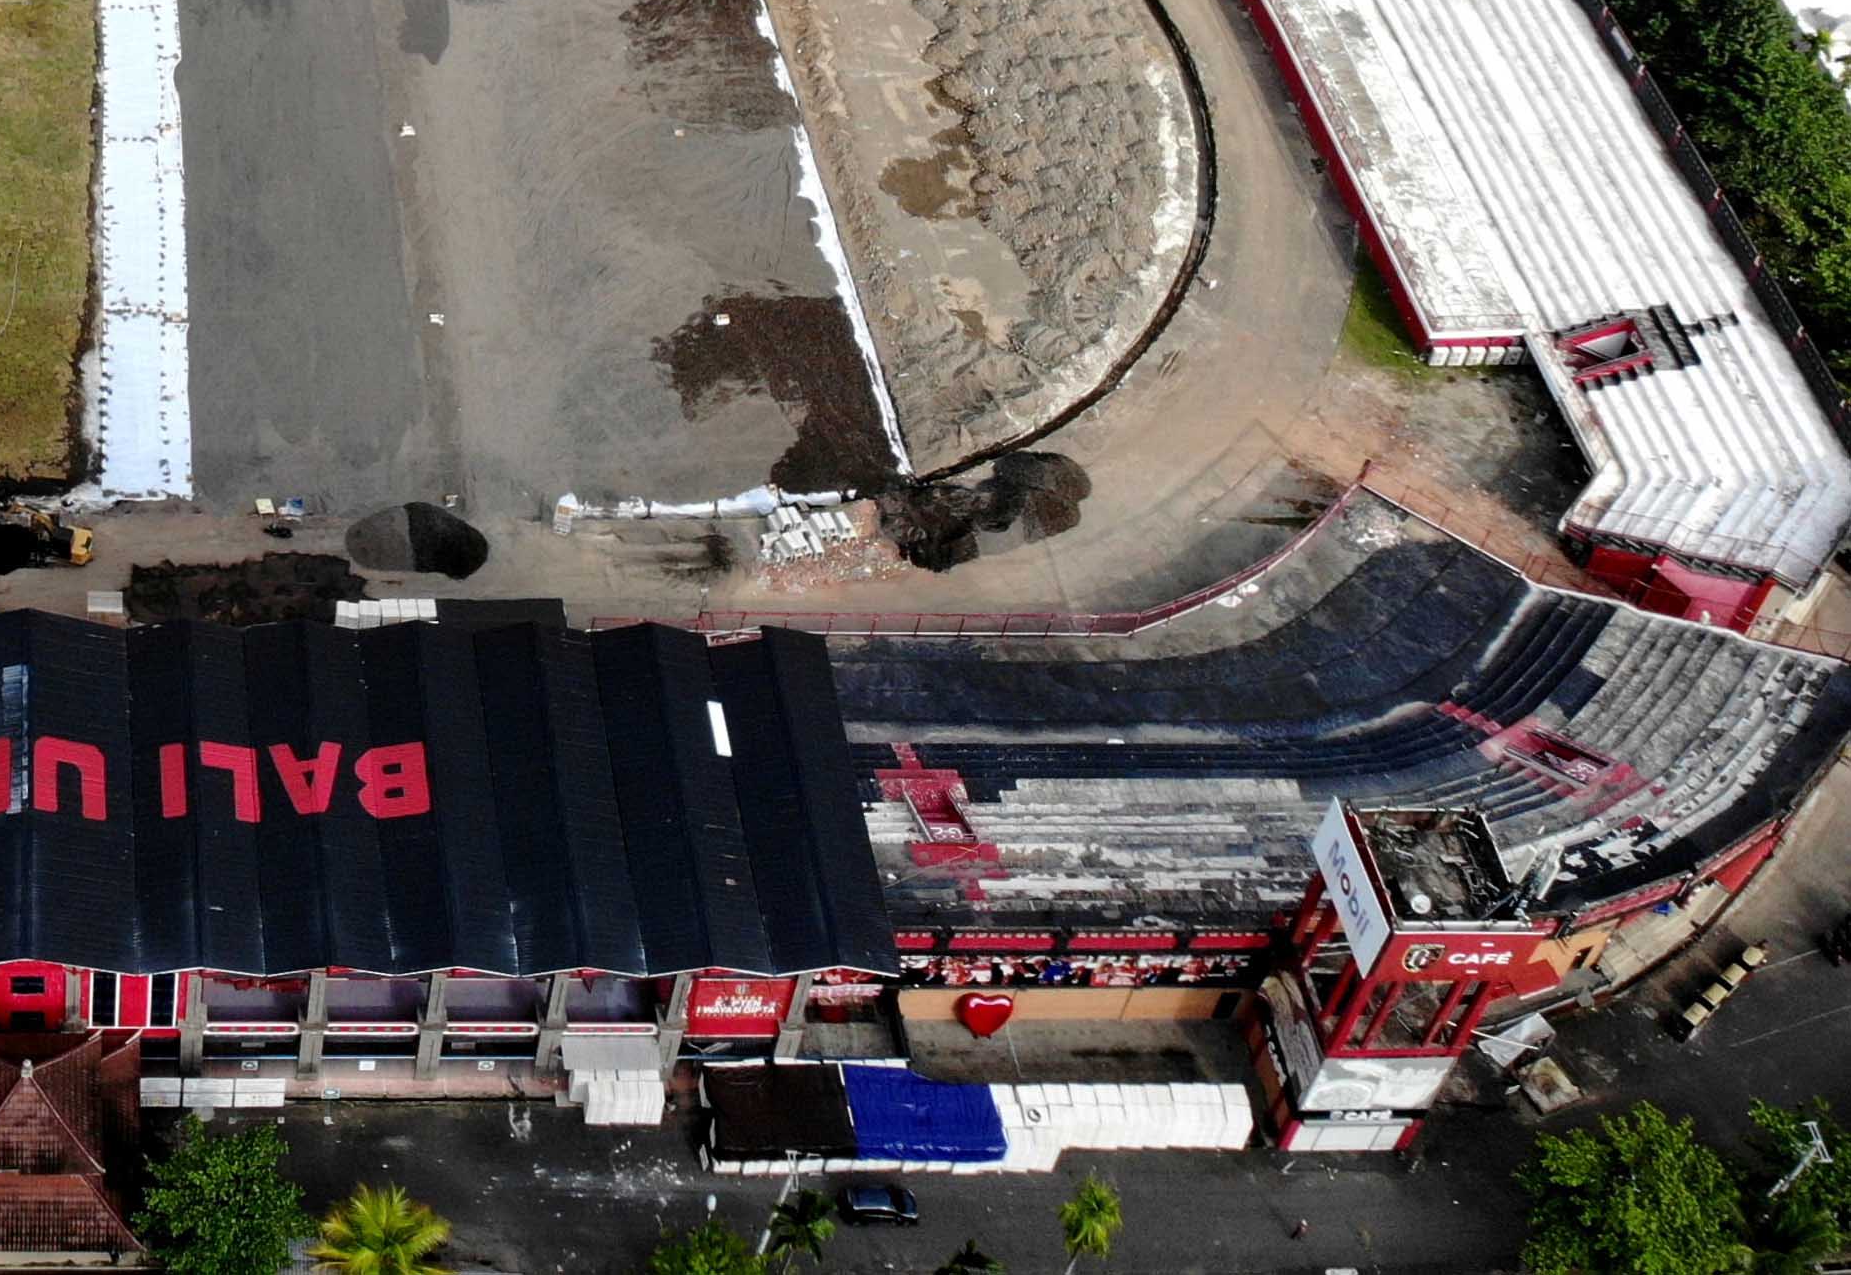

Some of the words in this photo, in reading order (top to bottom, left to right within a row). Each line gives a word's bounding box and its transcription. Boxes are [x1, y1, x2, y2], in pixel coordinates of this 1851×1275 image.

[160, 741, 431, 823] BALI
[1327, 840, 1371, 937] Mobil
[1447, 950, 1513, 965] CAFÉ
